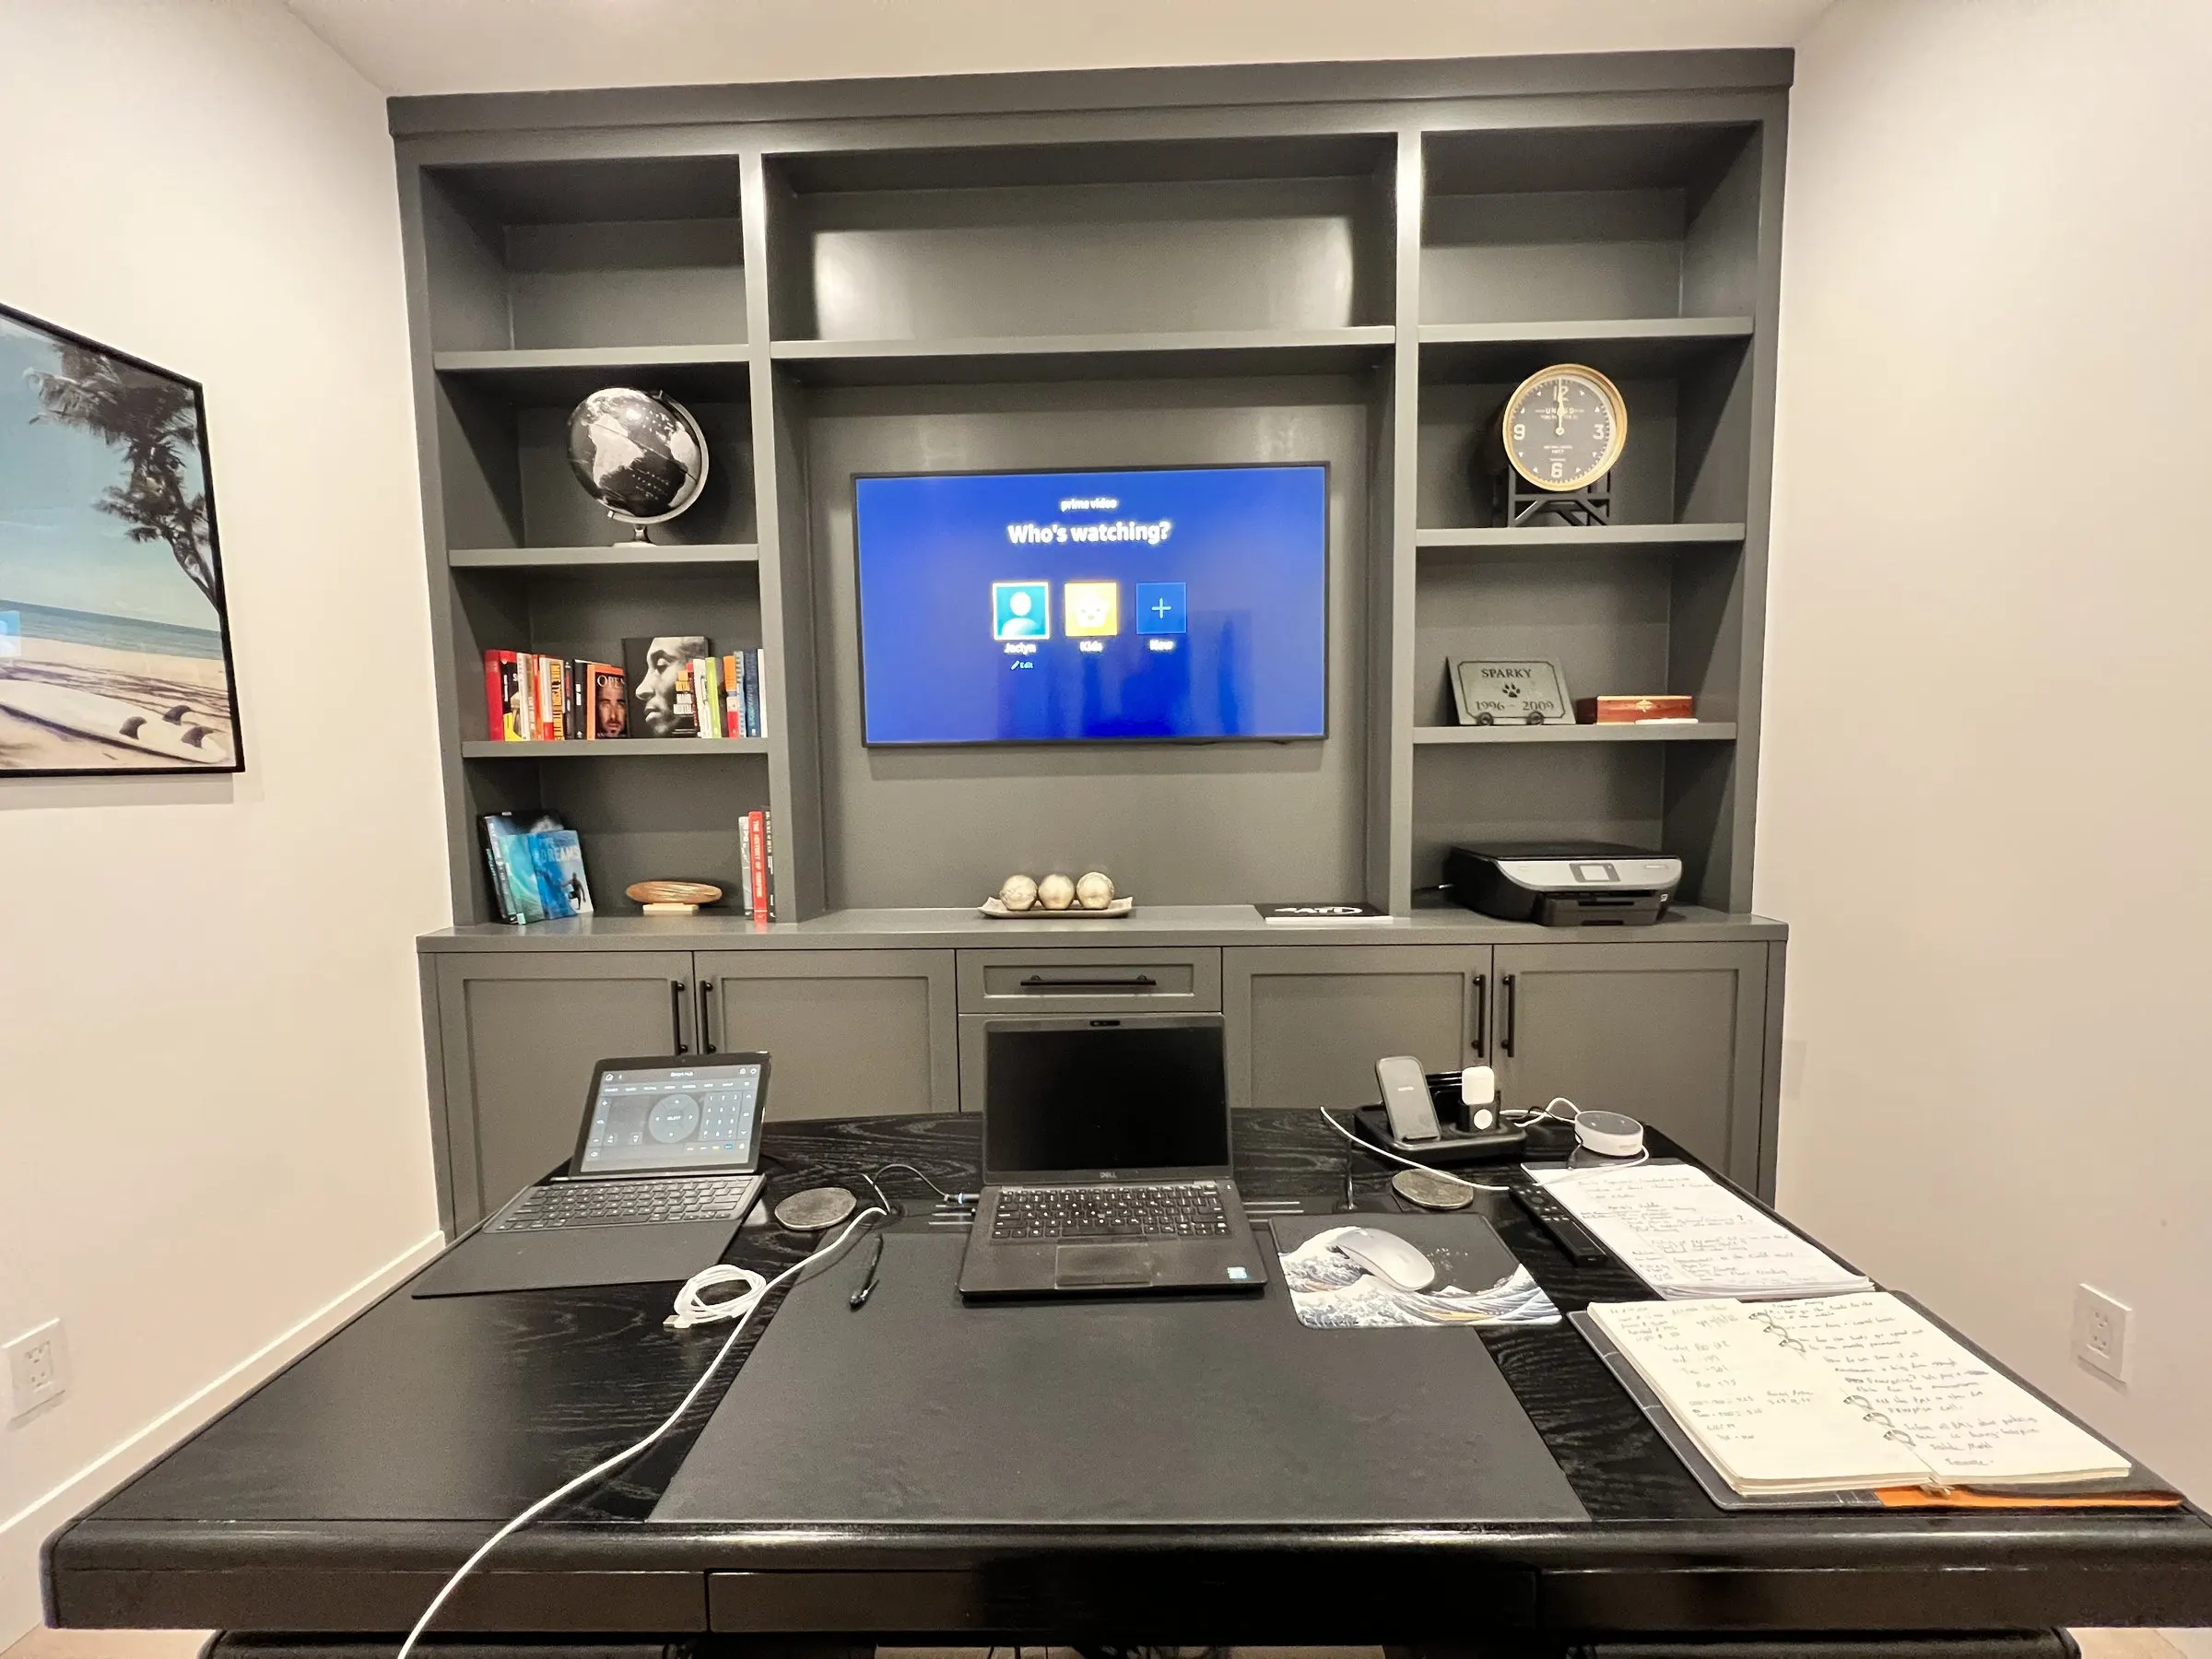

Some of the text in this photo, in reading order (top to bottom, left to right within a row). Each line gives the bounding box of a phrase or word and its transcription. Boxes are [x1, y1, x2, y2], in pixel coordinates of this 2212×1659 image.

[1513, 423, 1525, 441] 9
[1592, 423, 1605, 441] 3
[1550, 462, 1563, 478] 6
[1061, 497, 1118, 512] prime video
[1006, 520, 1171, 546] Who's watching?
[1079, 641, 1103, 652] Kids
[1481, 667, 1532, 679] SPARKY
[551, 684, 563, 705] TYSON
[1475, 700, 1505, 712] 1996
[1522, 700, 1555, 712] 2009
[752, 819, 760, 832] THE
[1099, 1171, 1118, 1180] DELL
